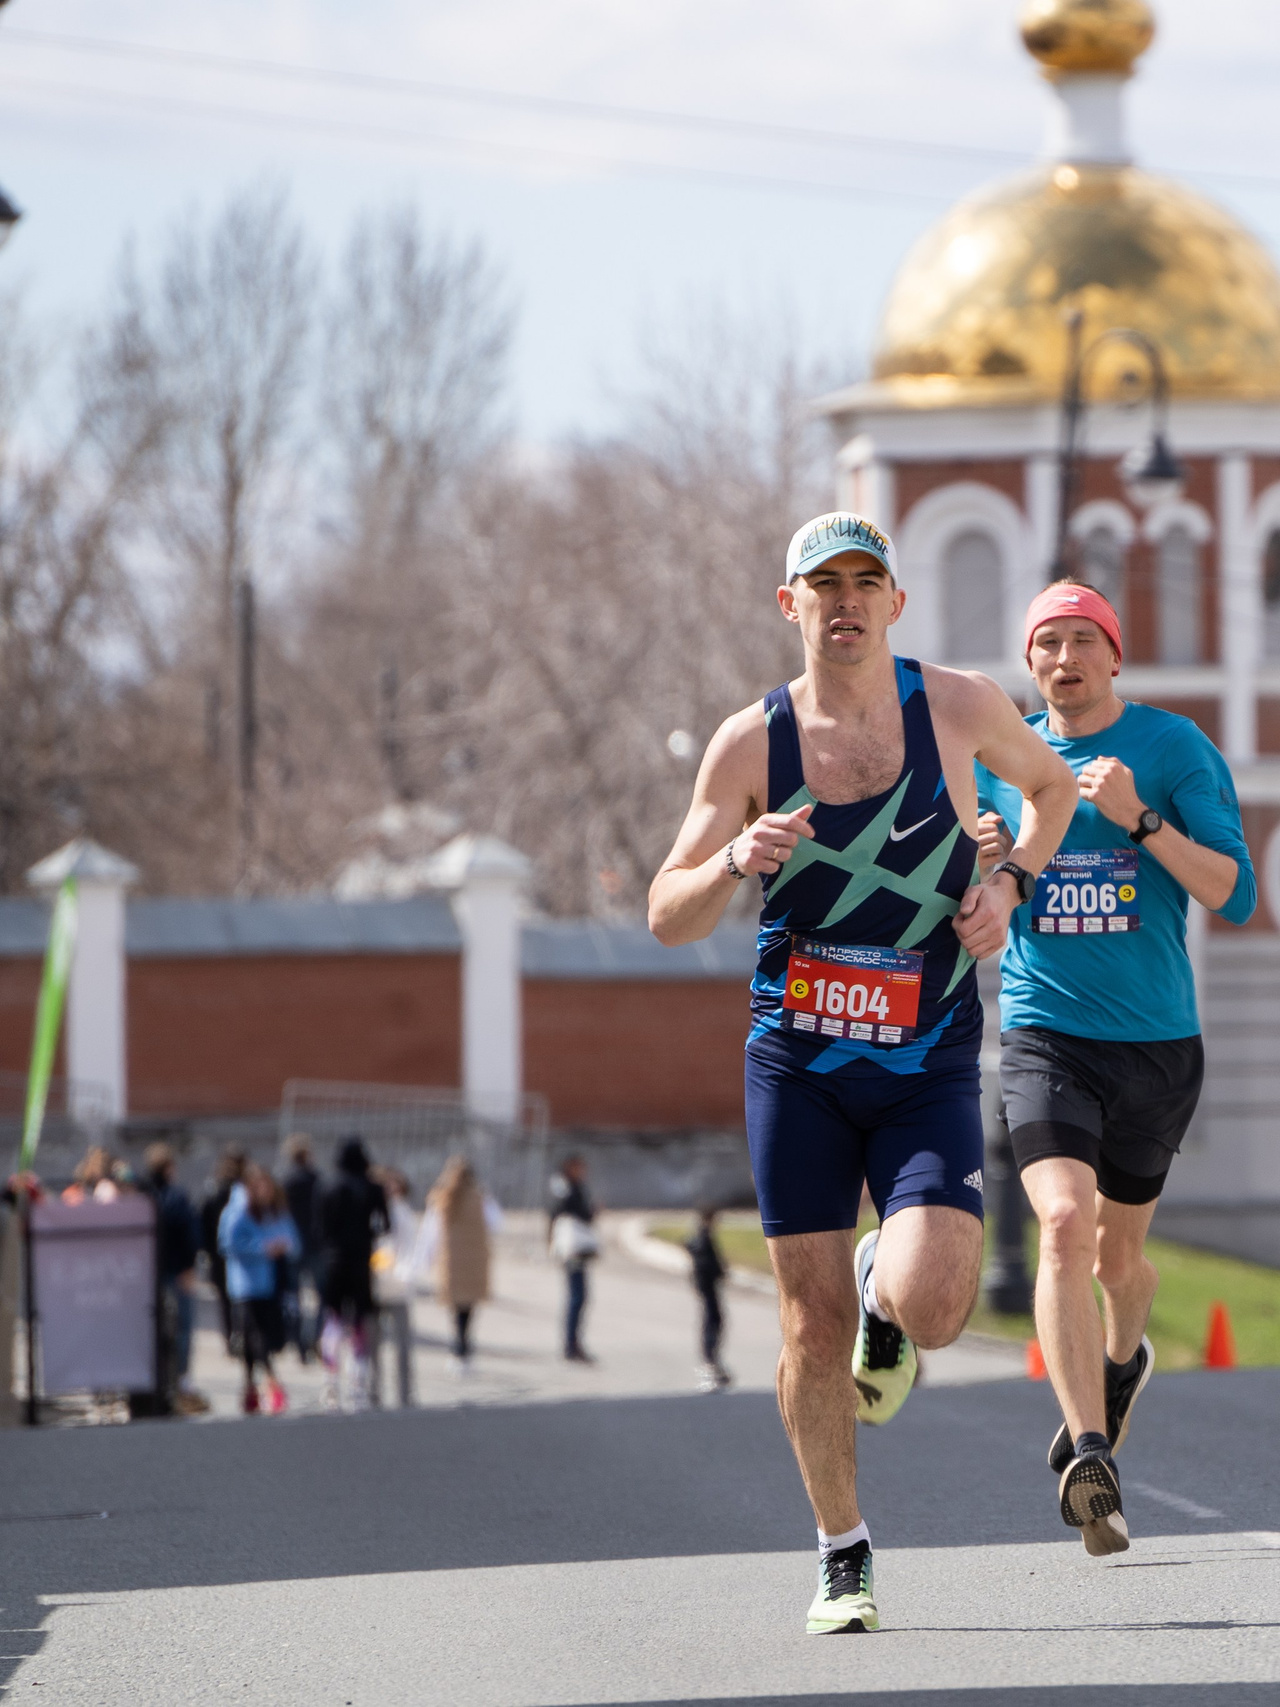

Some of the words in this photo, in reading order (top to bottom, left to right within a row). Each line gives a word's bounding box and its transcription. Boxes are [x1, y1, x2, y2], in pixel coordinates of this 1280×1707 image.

[1060, 871, 1092, 879] ЕВГЕНИЙ
[1046, 883, 1117, 914] 2006
[828, 952, 881, 965] КОСМОС
[837, 947, 881, 958] ПРОСТО
[813, 978, 890, 1021] 1604
